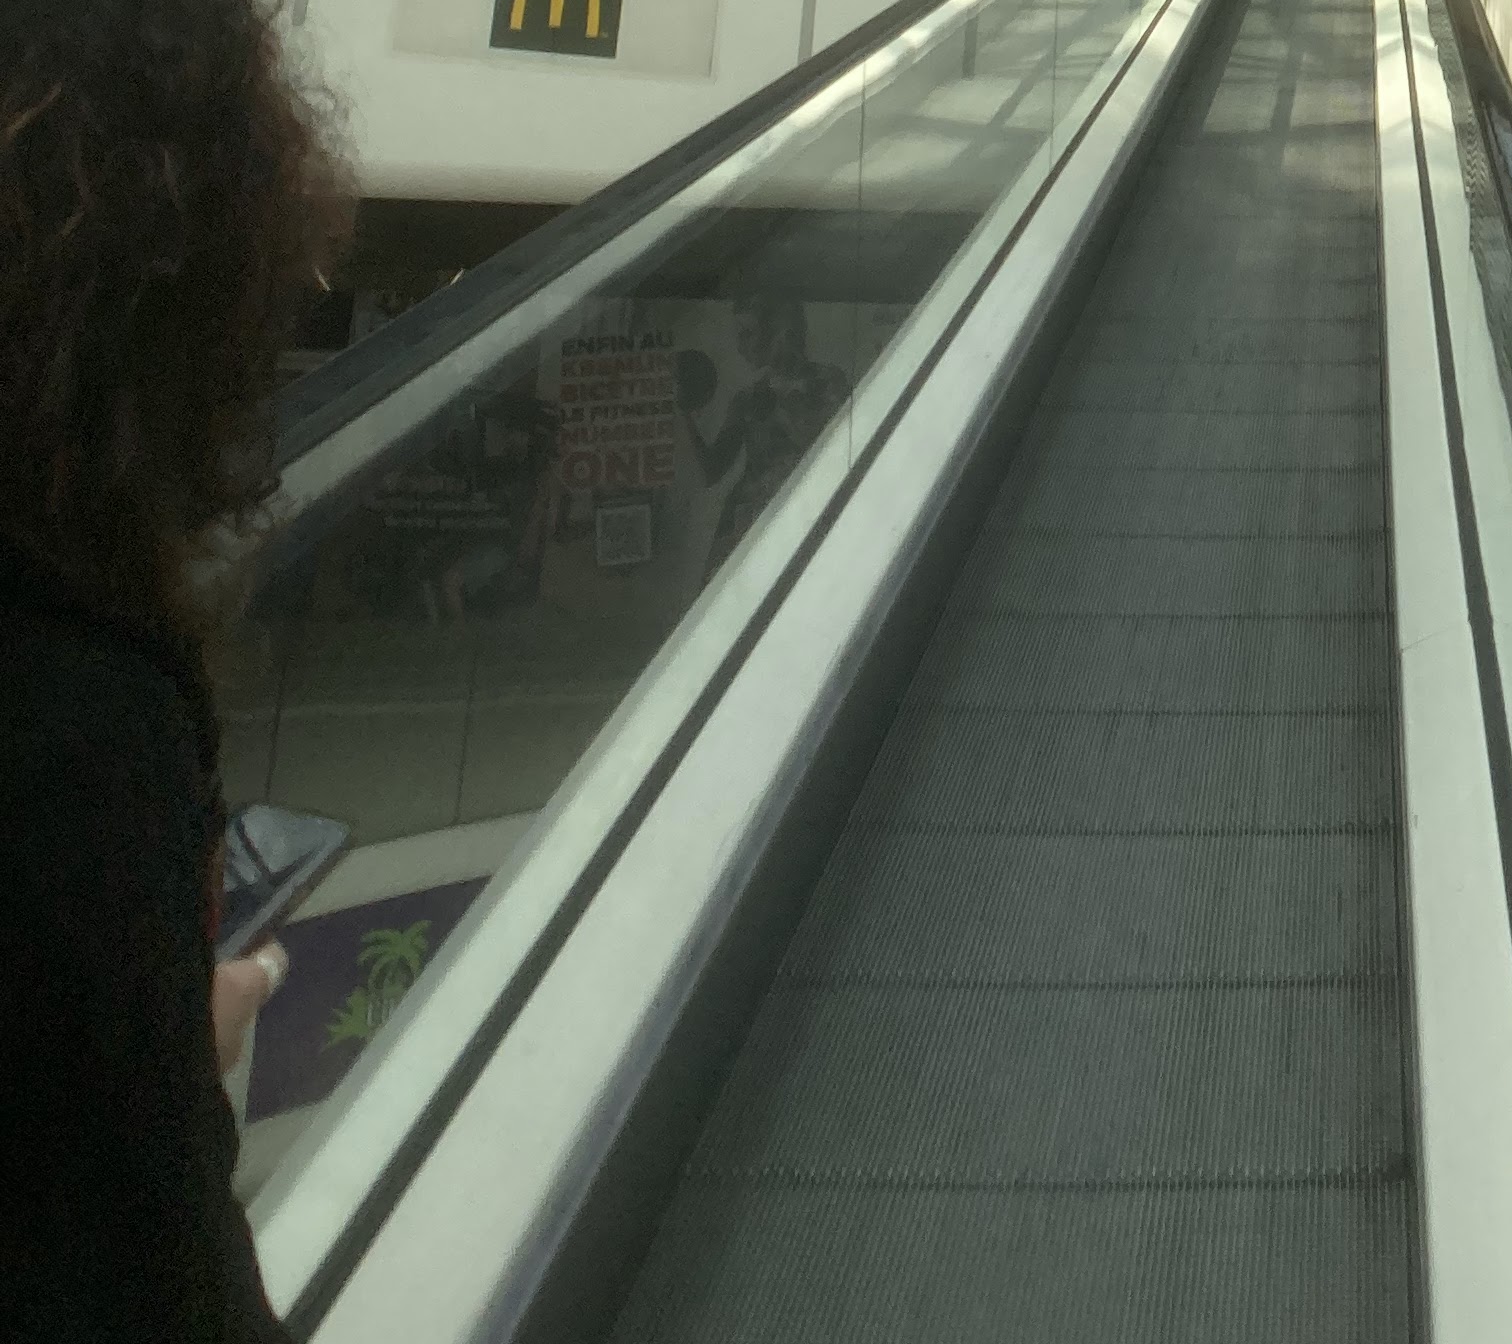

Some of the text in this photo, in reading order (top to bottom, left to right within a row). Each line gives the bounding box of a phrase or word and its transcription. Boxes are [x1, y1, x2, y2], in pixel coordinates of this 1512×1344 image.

[561, 330, 674, 357] ENFIN AU
[560, 420, 674, 445] NUMBER
[560, 444, 675, 489] ONE
